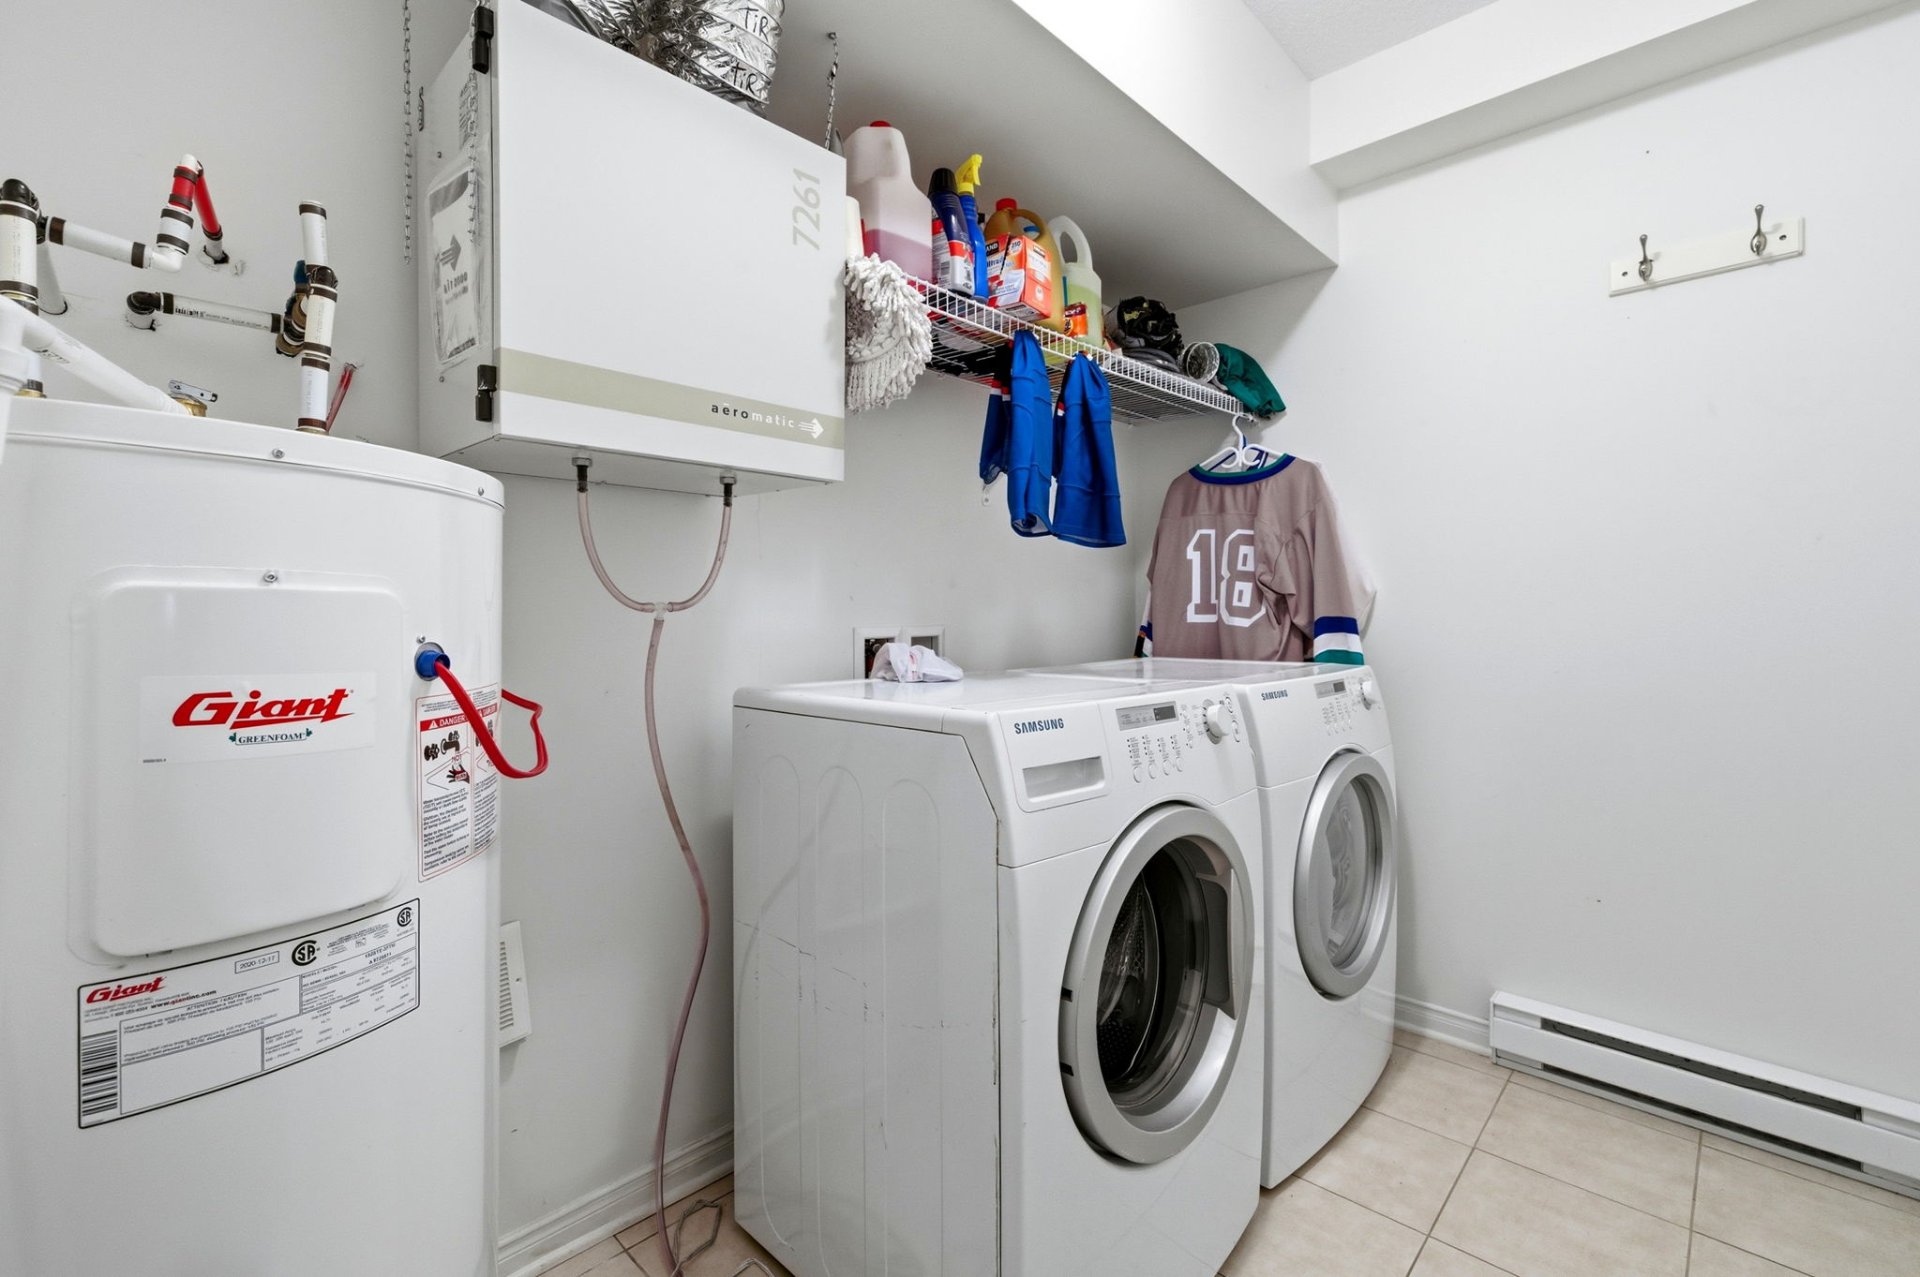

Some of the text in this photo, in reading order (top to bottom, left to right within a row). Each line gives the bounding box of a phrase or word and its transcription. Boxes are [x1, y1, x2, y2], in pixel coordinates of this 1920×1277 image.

[791, 167, 822, 252] 7261
[1186, 528, 1267, 628] 18
[1261, 689, 1289, 701] SAMSUNG
[172, 688, 356, 730] Giant
[439, 714, 467, 727] DANGER
[1014, 718, 1065, 735] SAMSUNG
[238, 732, 305, 744] GREENFOAM
[86, 976, 167, 1004] Giant
